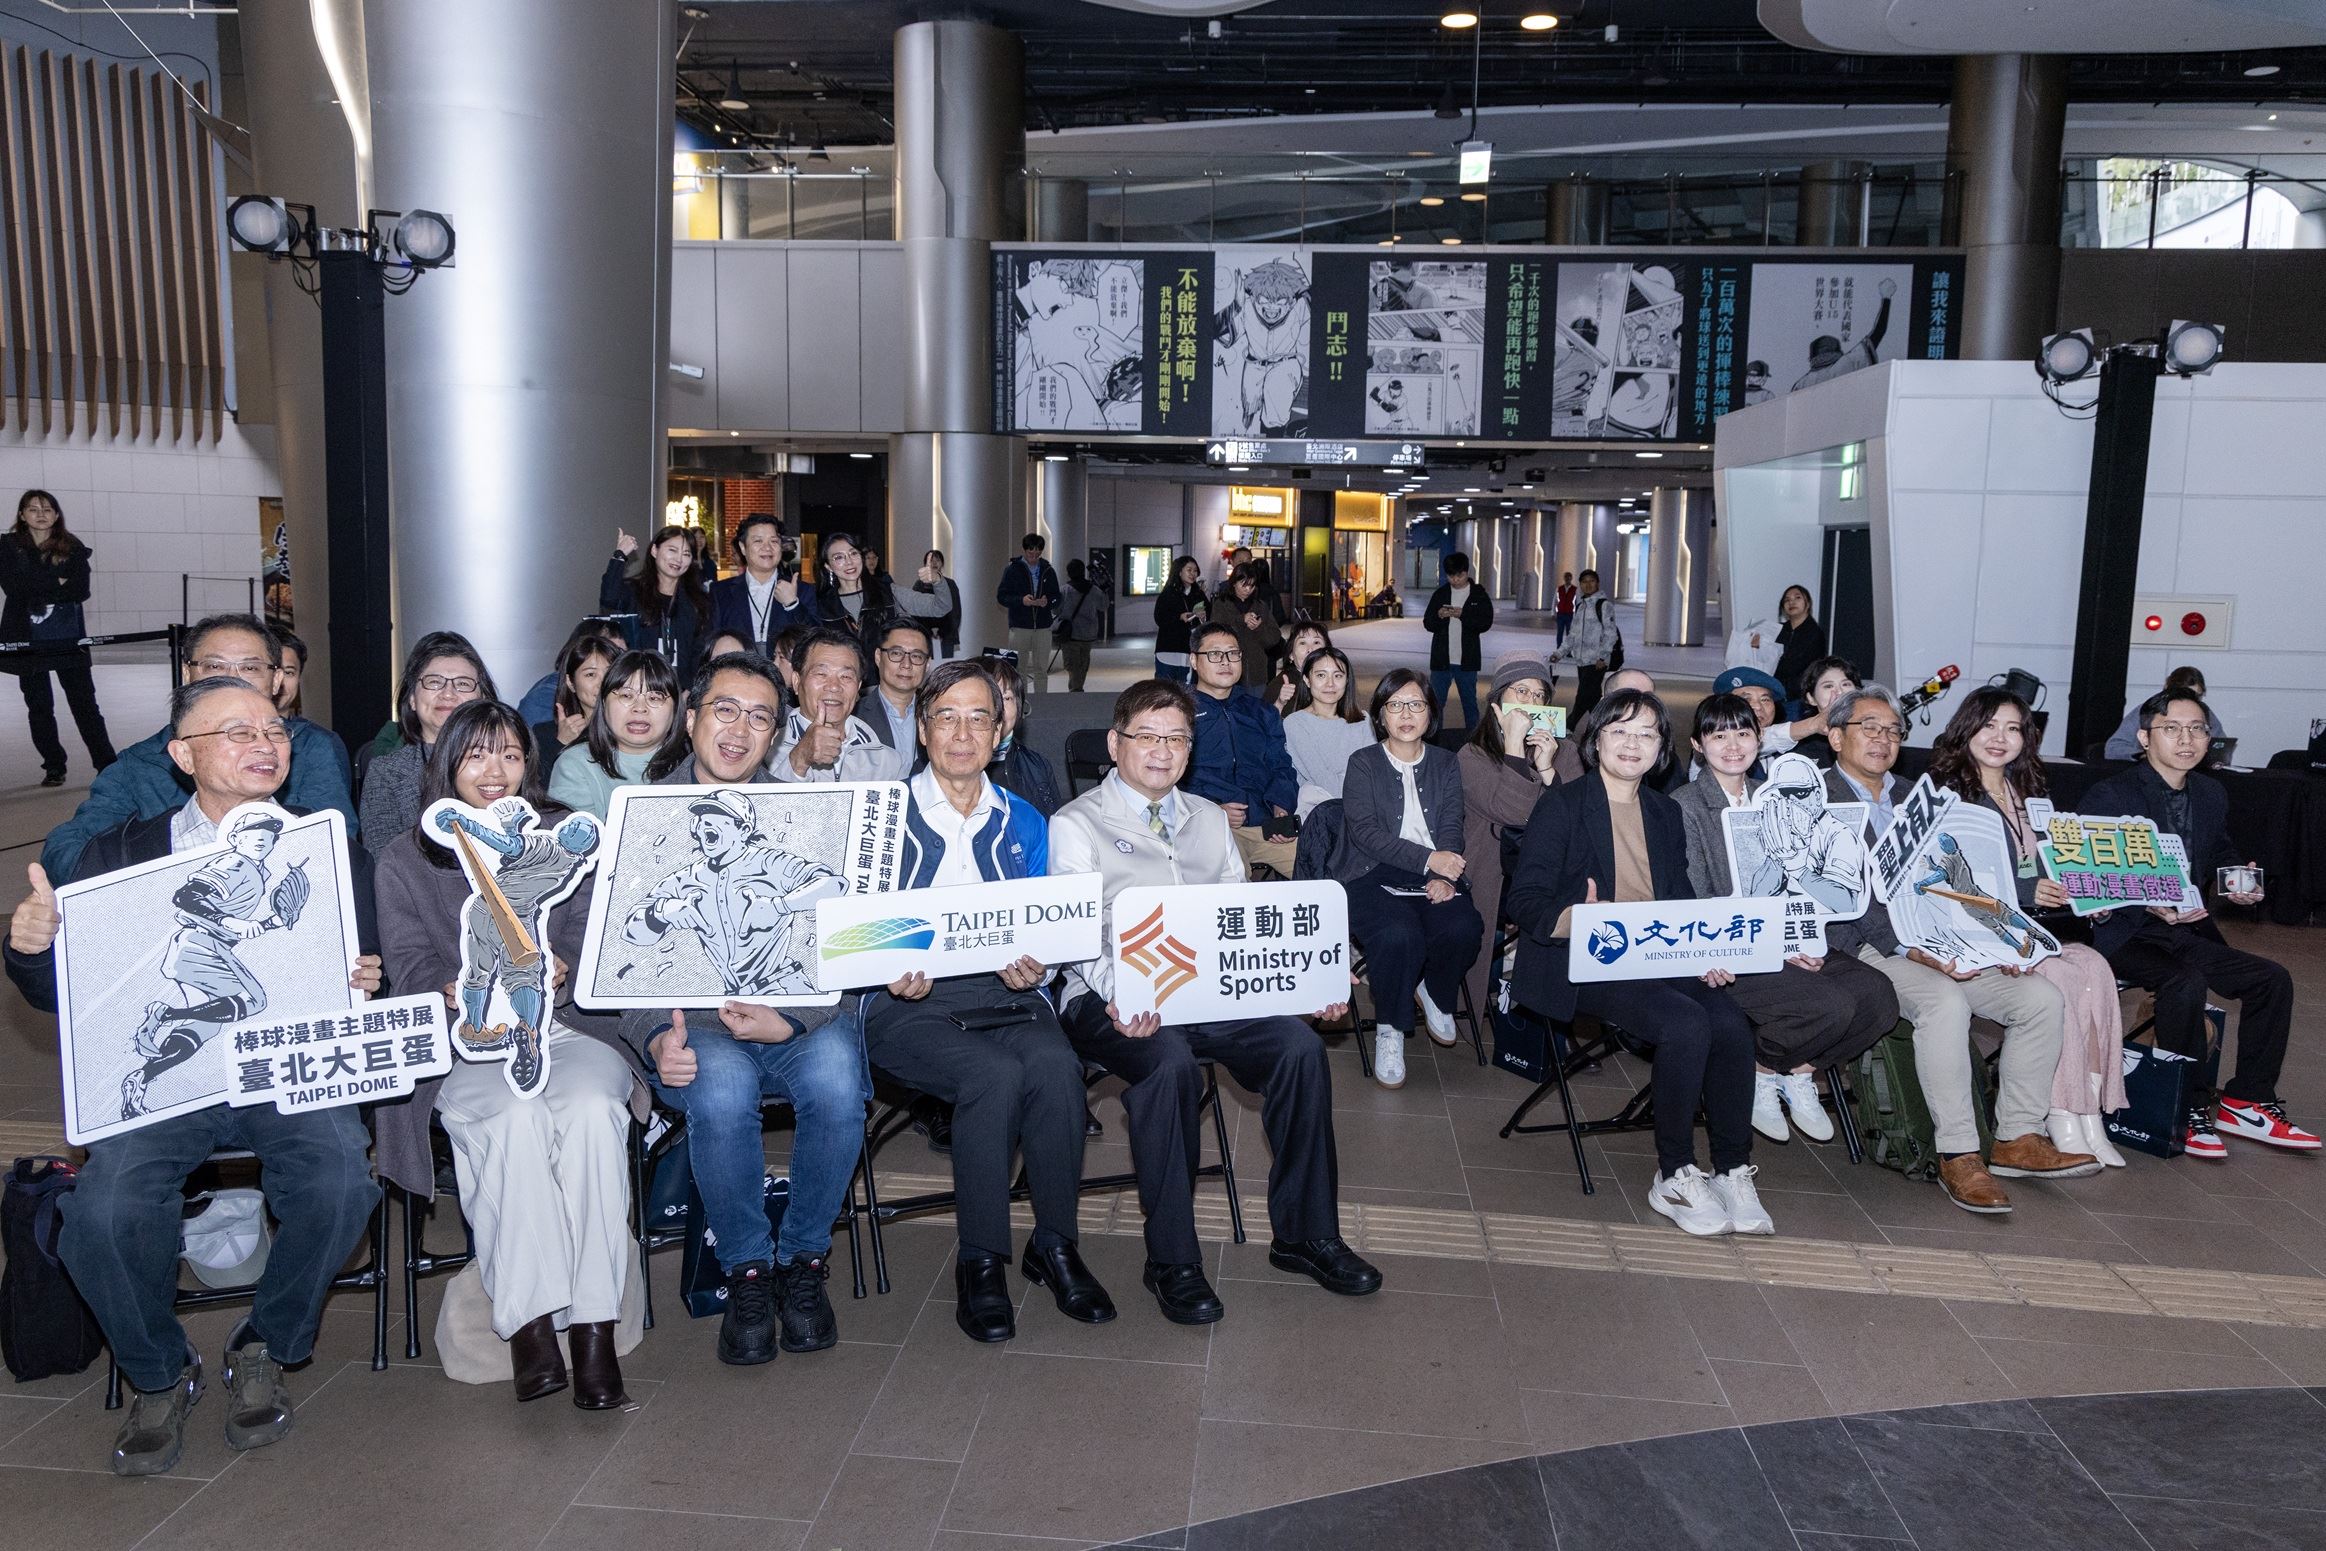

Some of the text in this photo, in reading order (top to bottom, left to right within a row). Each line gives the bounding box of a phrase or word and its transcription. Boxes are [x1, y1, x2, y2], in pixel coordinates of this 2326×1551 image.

[1175, 268, 1198, 402] 不能放棄啊！
[1502, 263, 1524, 437] 只希望能再跑快一點。
[857, 789, 881, 870] 臺北大巨蛋
[877, 787, 901, 893] 棒球漫畫主題特展
[1873, 779, 1950, 890] 壘上有人
[2048, 817, 2158, 868] 雙百萬
[2060, 870, 2184, 901] 運動漫畫徵選
[941, 900, 1097, 933] TAIPEI DOME
[1216, 903, 1320, 941] 運動部
[1635, 914, 1765, 947] 文化部
[943, 930, 1015, 952] 臺北大巨蛋
[1219, 943, 1342, 972] Ministry of
[1644, 947, 1754, 961] MINISTRY OF CULTURE
[1219, 972, 1296, 1000] Sports
[234, 1005, 434, 1053] 棒球漫畫主題特展
[237, 1033, 438, 1094] 臺北大巨蛋
[286, 1075, 399, 1106] TAIPEI DOME
